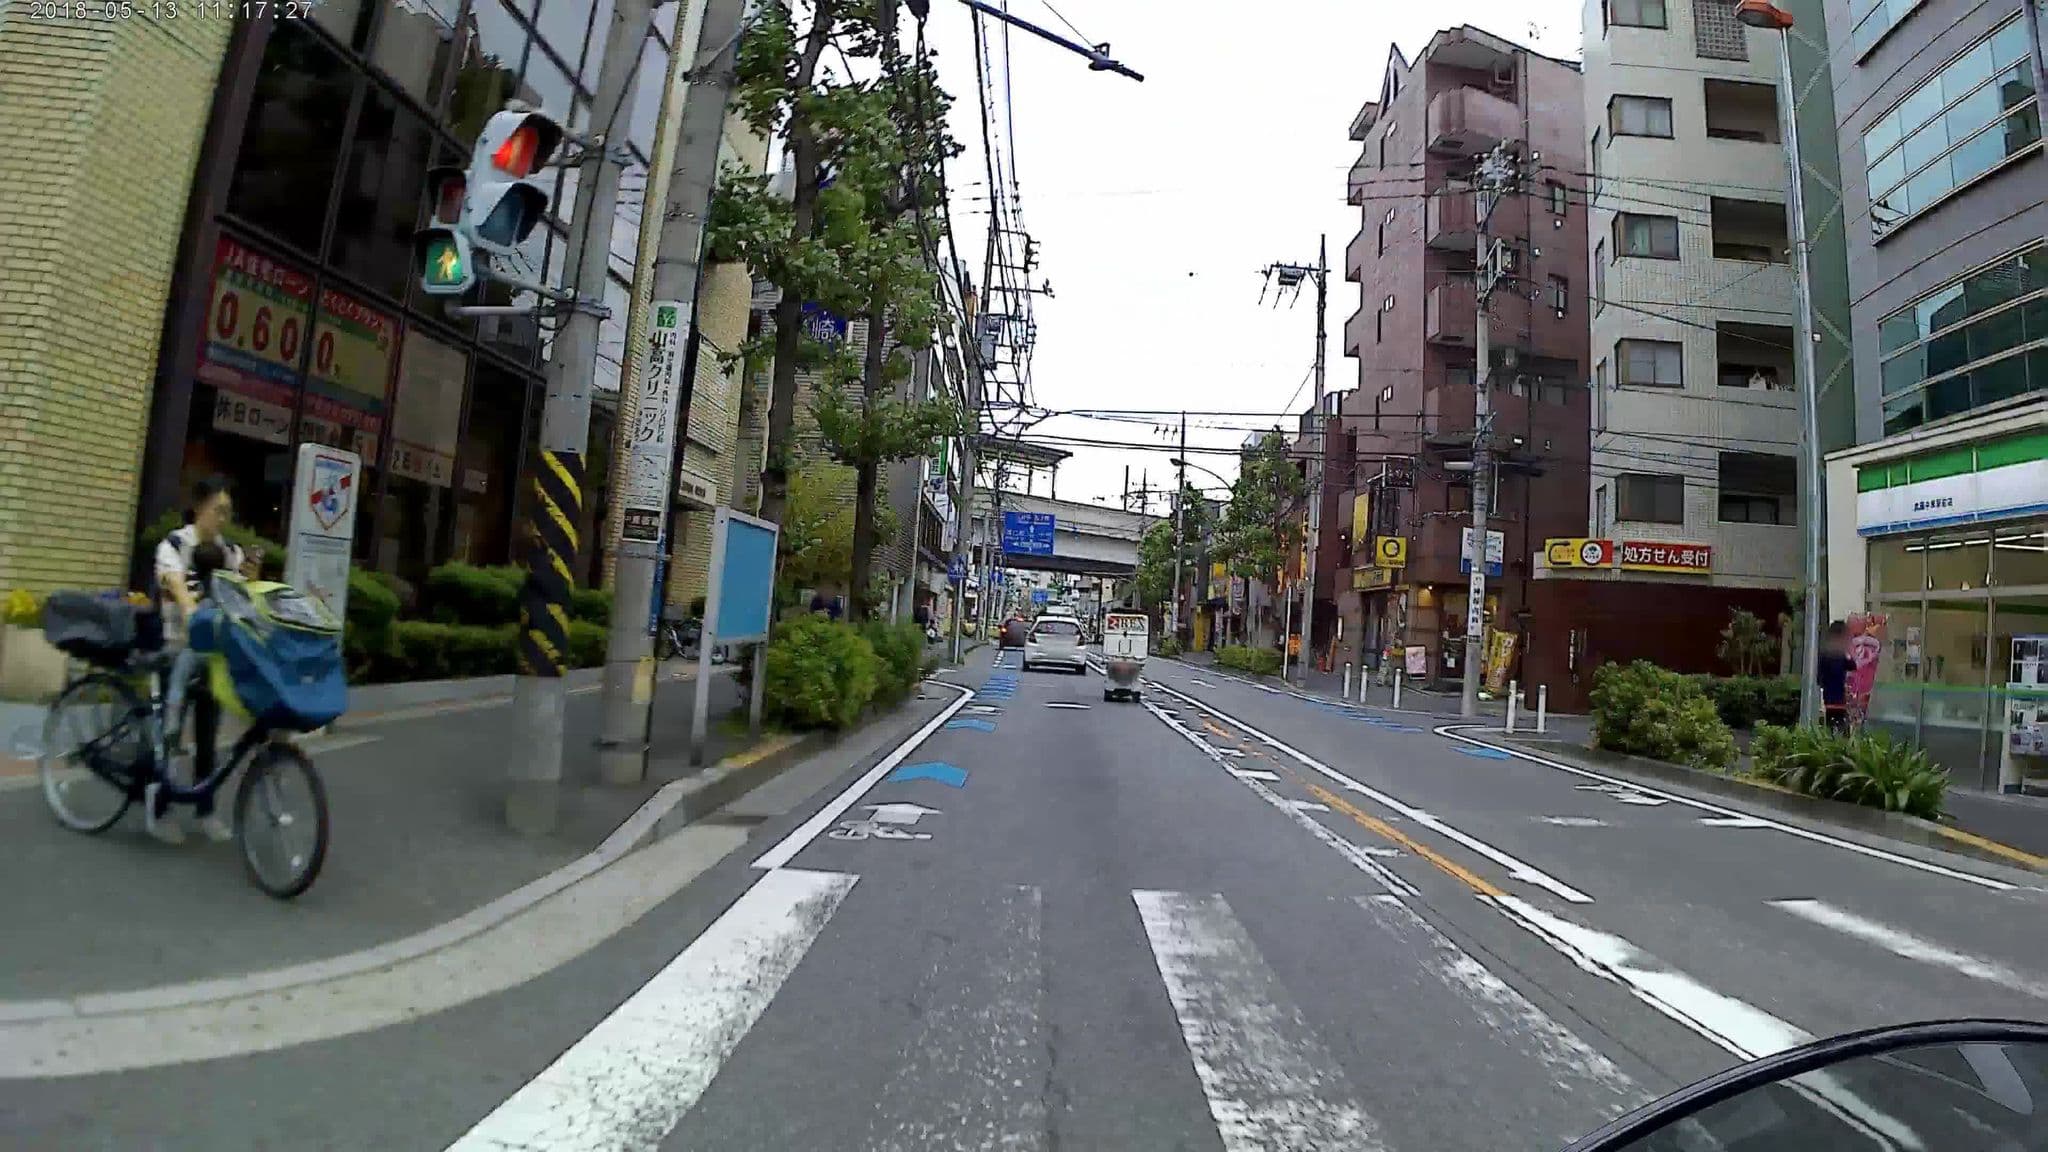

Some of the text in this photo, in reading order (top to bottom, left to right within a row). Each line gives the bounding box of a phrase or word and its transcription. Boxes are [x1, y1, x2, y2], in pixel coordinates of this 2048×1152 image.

[1623, 545, 1709, 567] 処方せん受付
